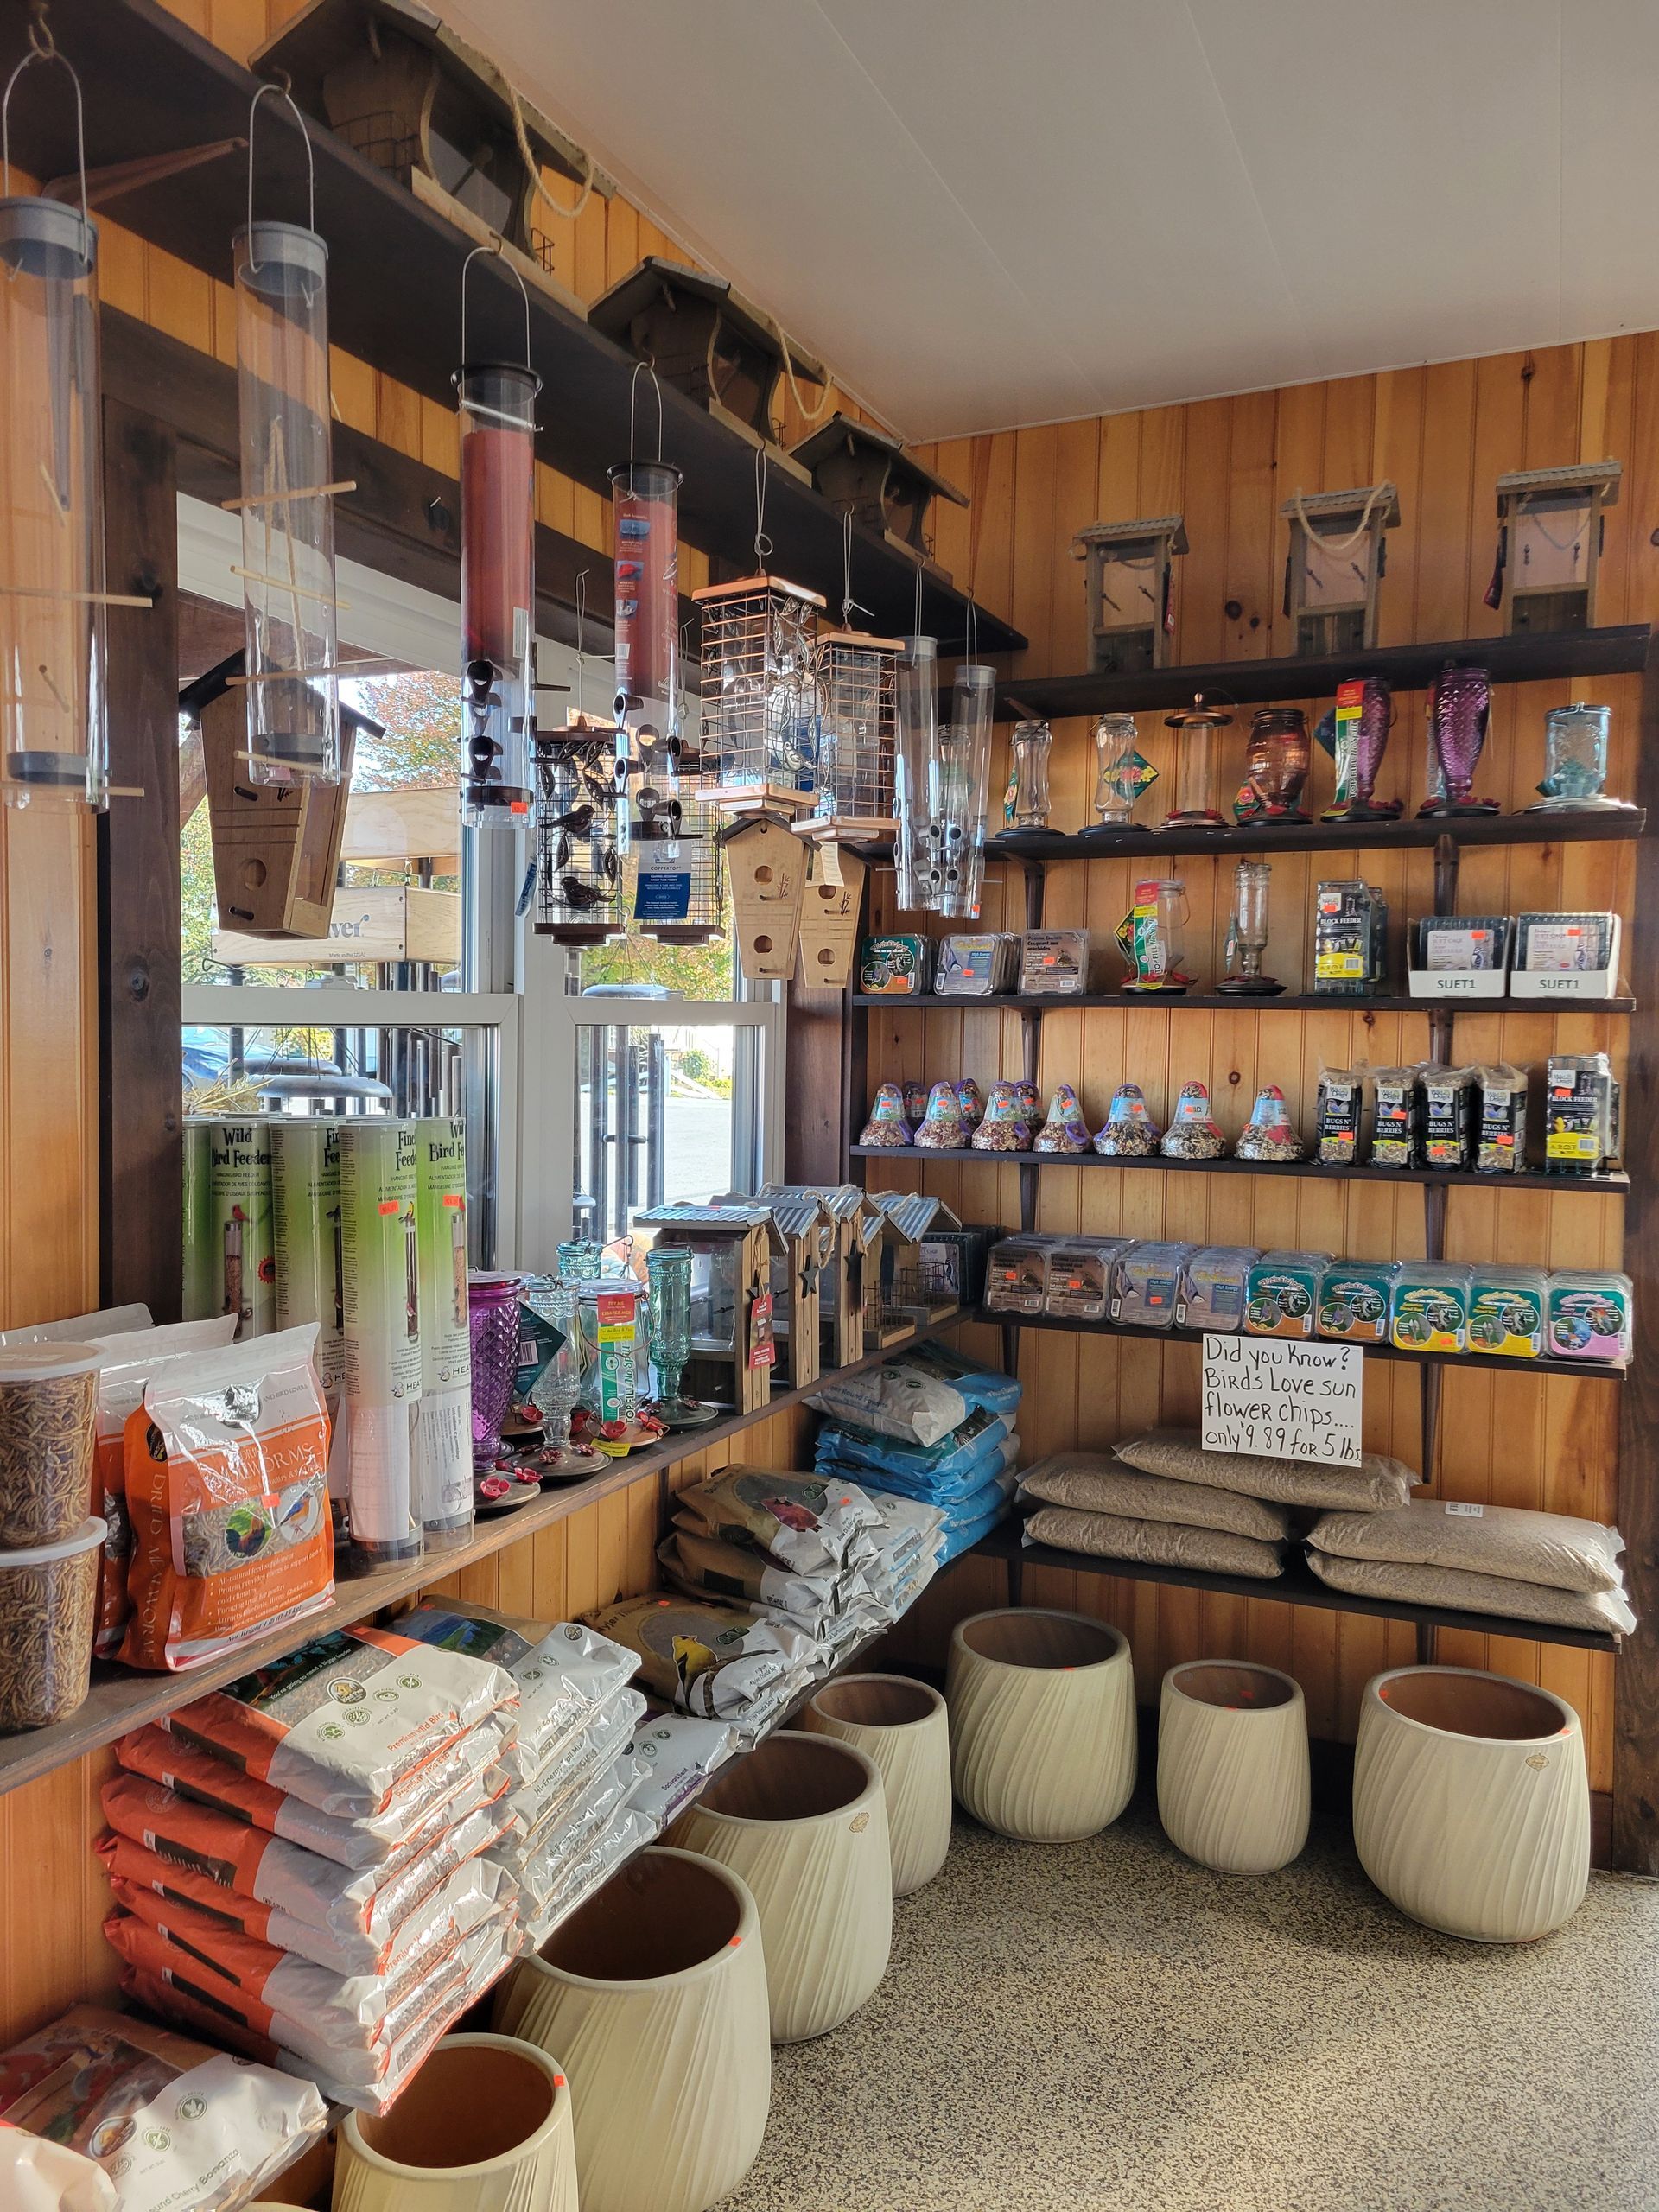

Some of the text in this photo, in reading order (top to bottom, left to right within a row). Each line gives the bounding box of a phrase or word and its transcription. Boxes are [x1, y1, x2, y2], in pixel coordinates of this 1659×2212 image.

[1437, 979, 1476, 989] SUET1
[1539, 979, 1580, 989] SUET1
[222, 1128, 252, 1147] Wild
[233, 1148, 272, 1168] Feeder
[429, 1141, 454, 1162] Bird
[1206, 1337, 1242, 1362] Did
[1249, 1350, 1282, 1370] you
[625, 1371, 633, 1383] No
[1270, 1367, 1314, 1395] Love
[1319, 1380, 1356, 1398] sun
[625, 1384, 635, 1406] FILL
[625, 1406, 636, 1425] TOP
[1205, 1425, 1240, 1452] only
[1321, 1433, 1336, 1457] 5
[218, 1569, 251, 1586] All-natural
[218, 1583, 241, 1596] Protein
[217, 1596, 232, 1605] cold
[269, 1687, 287, 1700] You're
[286, 1678, 302, 1690] going
[387, 1731, 416, 1752] Premium
[429, 1712, 444, 1725] Bird
[534, 1742, 583, 1796] Hi-Energy Mix
[171, 2148, 240, 2200] Cherry Bonanza
